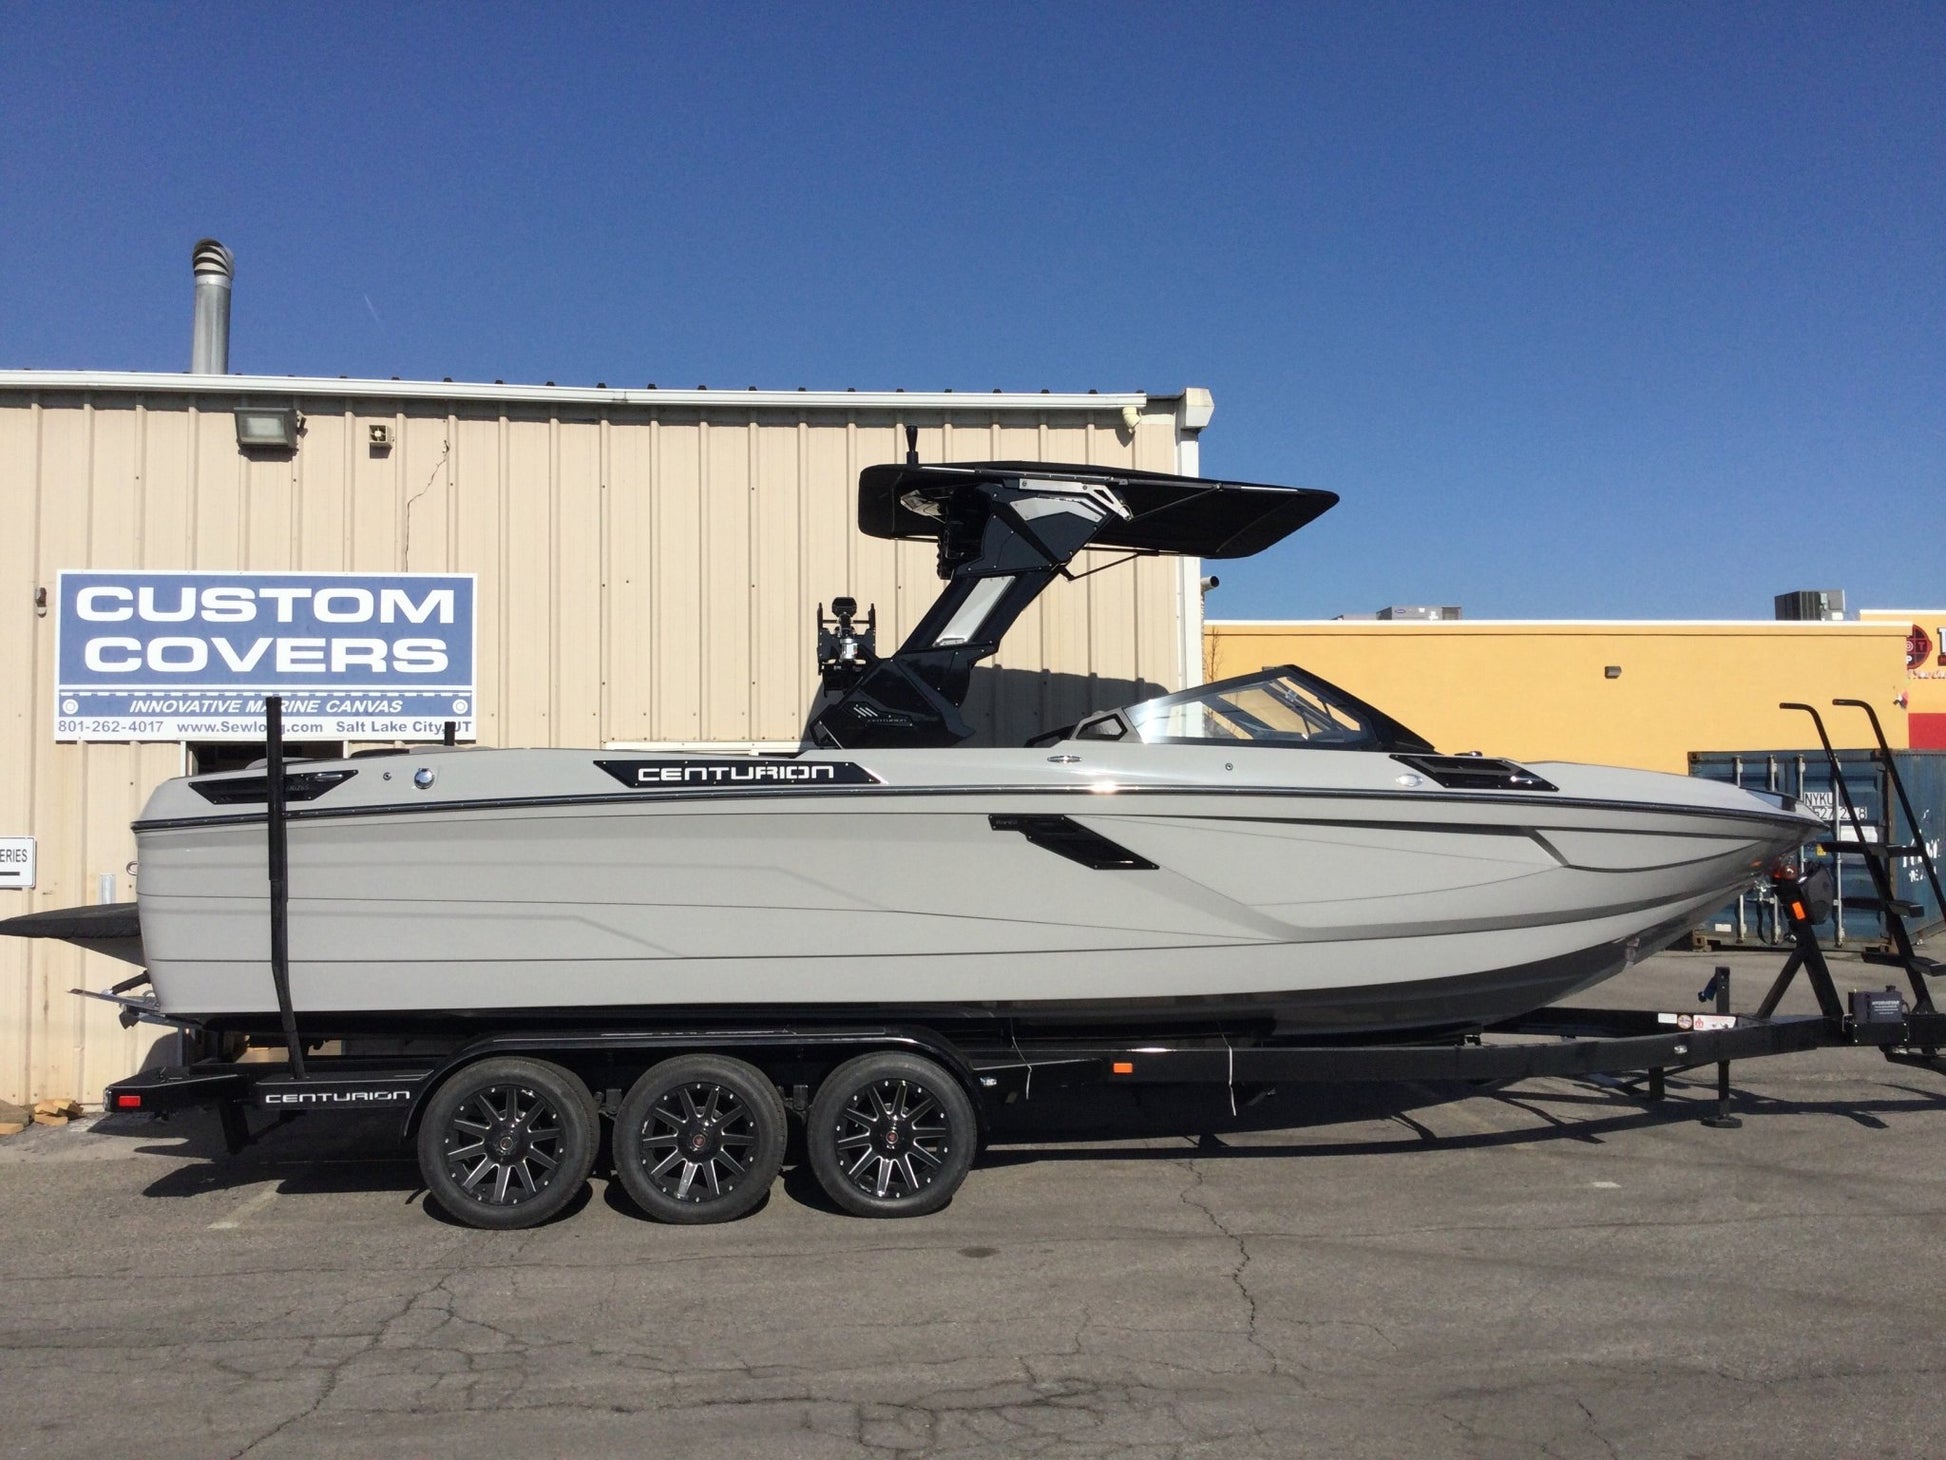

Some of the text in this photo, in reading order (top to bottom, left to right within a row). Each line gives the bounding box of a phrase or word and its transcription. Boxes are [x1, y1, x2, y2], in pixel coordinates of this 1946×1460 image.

[76, 586, 454, 624] CUSTOM
[84, 637, 449, 673] COVERS
[129, 700, 403, 713] INNOVATIVE MRINE CANVAS
[58, 720, 164, 733] 801-262-4017
[335, 720, 366, 733] Salt
[371, 720, 408, 733] Lake
[637, 765, 835, 782] CENTURION
[0, 848, 28, 863] ERIES
[265, 1091, 411, 1104] CENTURION
